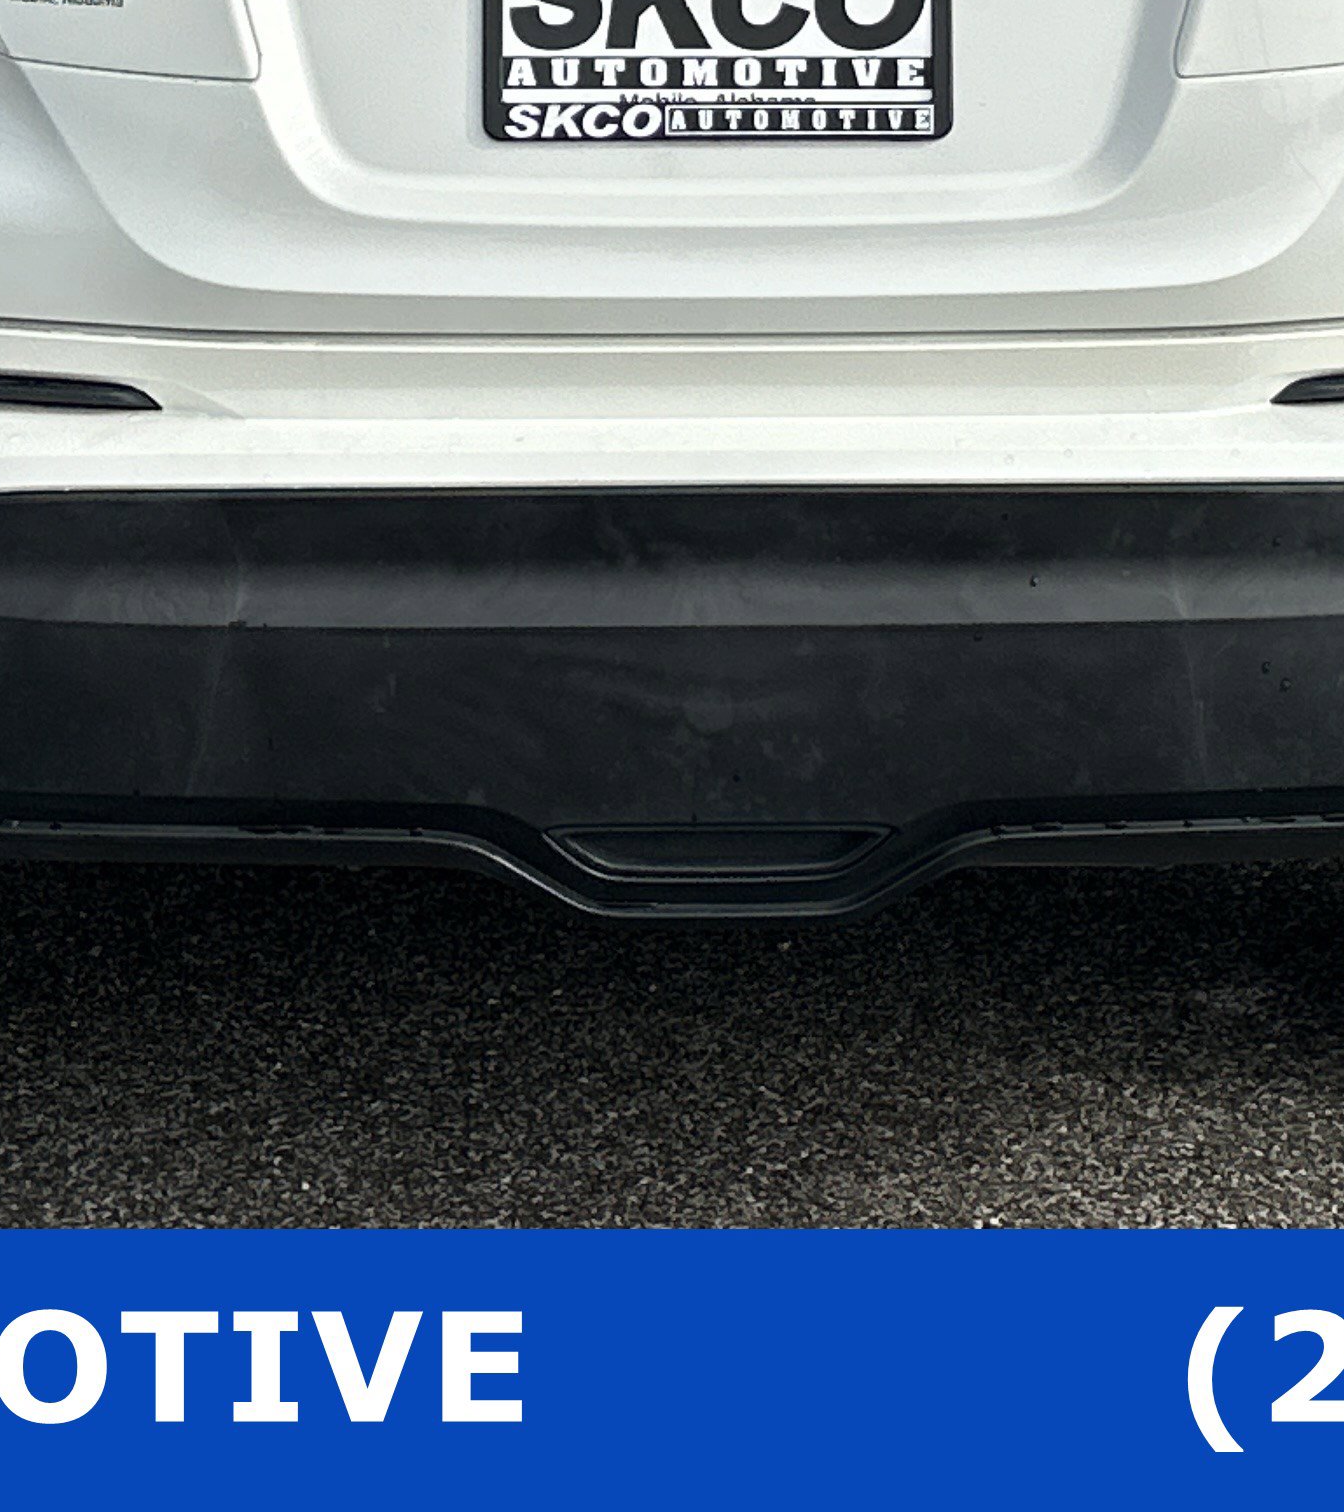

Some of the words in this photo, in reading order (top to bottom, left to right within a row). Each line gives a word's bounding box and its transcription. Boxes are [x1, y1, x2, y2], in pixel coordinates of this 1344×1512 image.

[507, 58, 926, 87] AUTOMOTIVE
[504, 104, 662, 138] SKCO
[671, 109, 932, 131] AUTOMOTIVE
